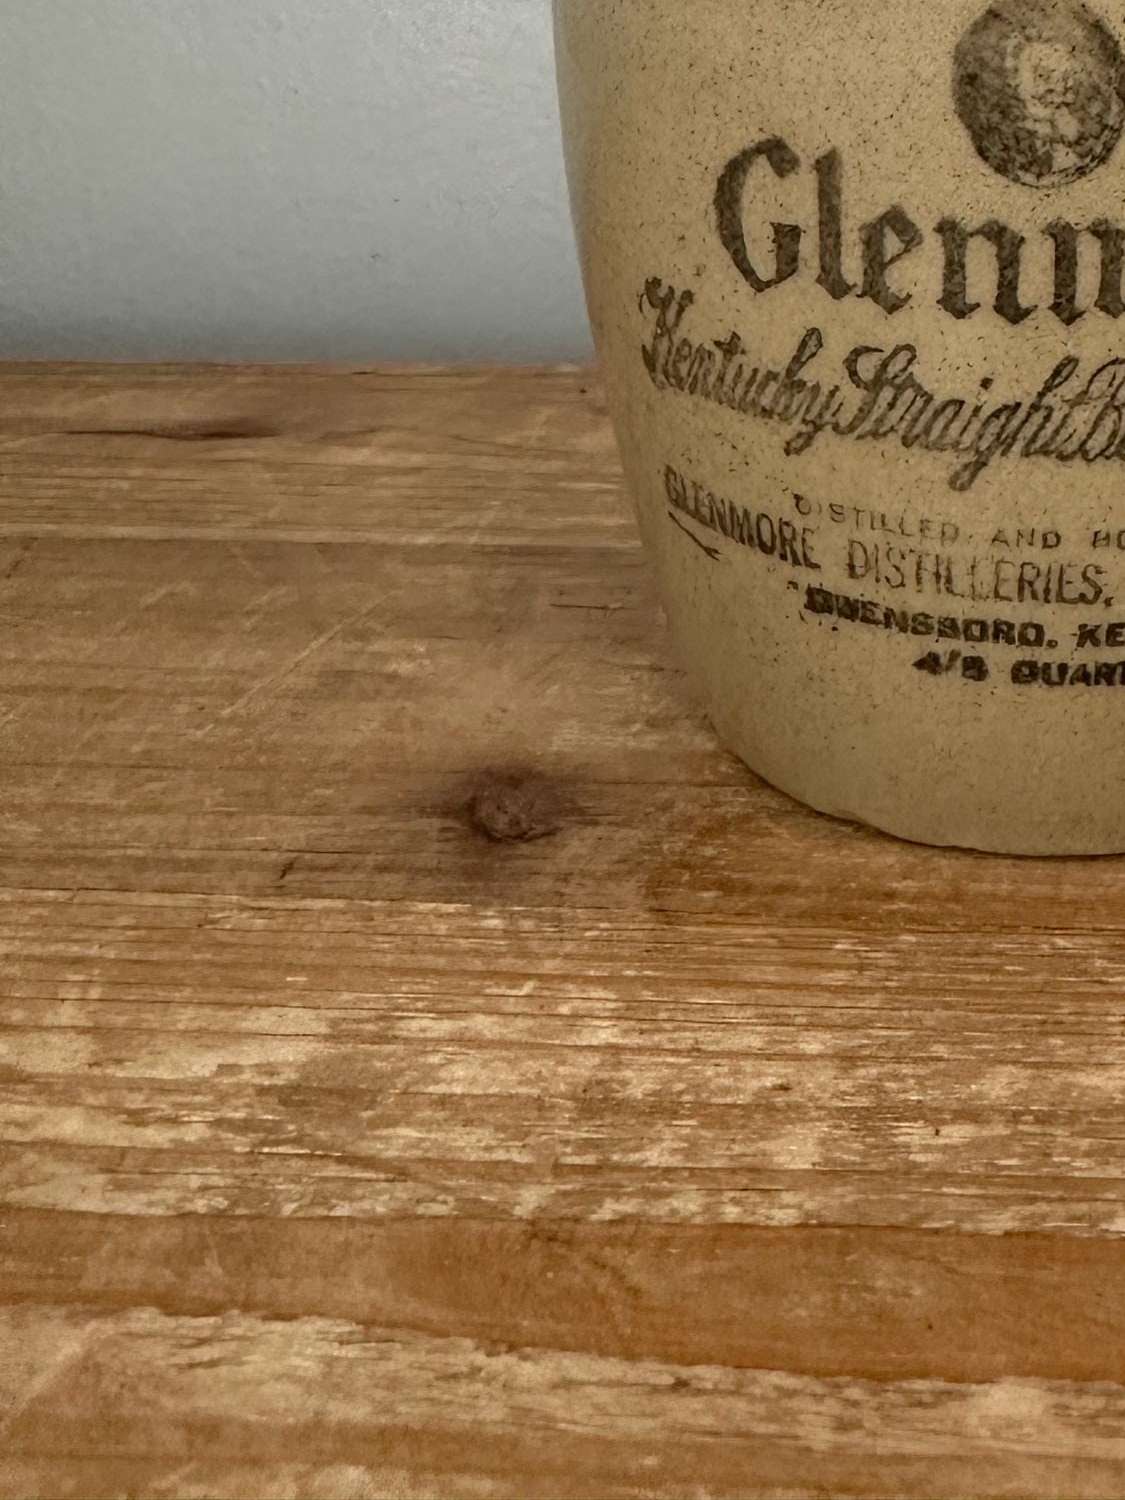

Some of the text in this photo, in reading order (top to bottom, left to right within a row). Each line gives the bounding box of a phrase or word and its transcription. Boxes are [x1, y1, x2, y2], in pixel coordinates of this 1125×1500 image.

[640, 276, 840, 456] Kentucky
[830, 343, 1082, 491] Straight
[992, 526, 1062, 551] AND
